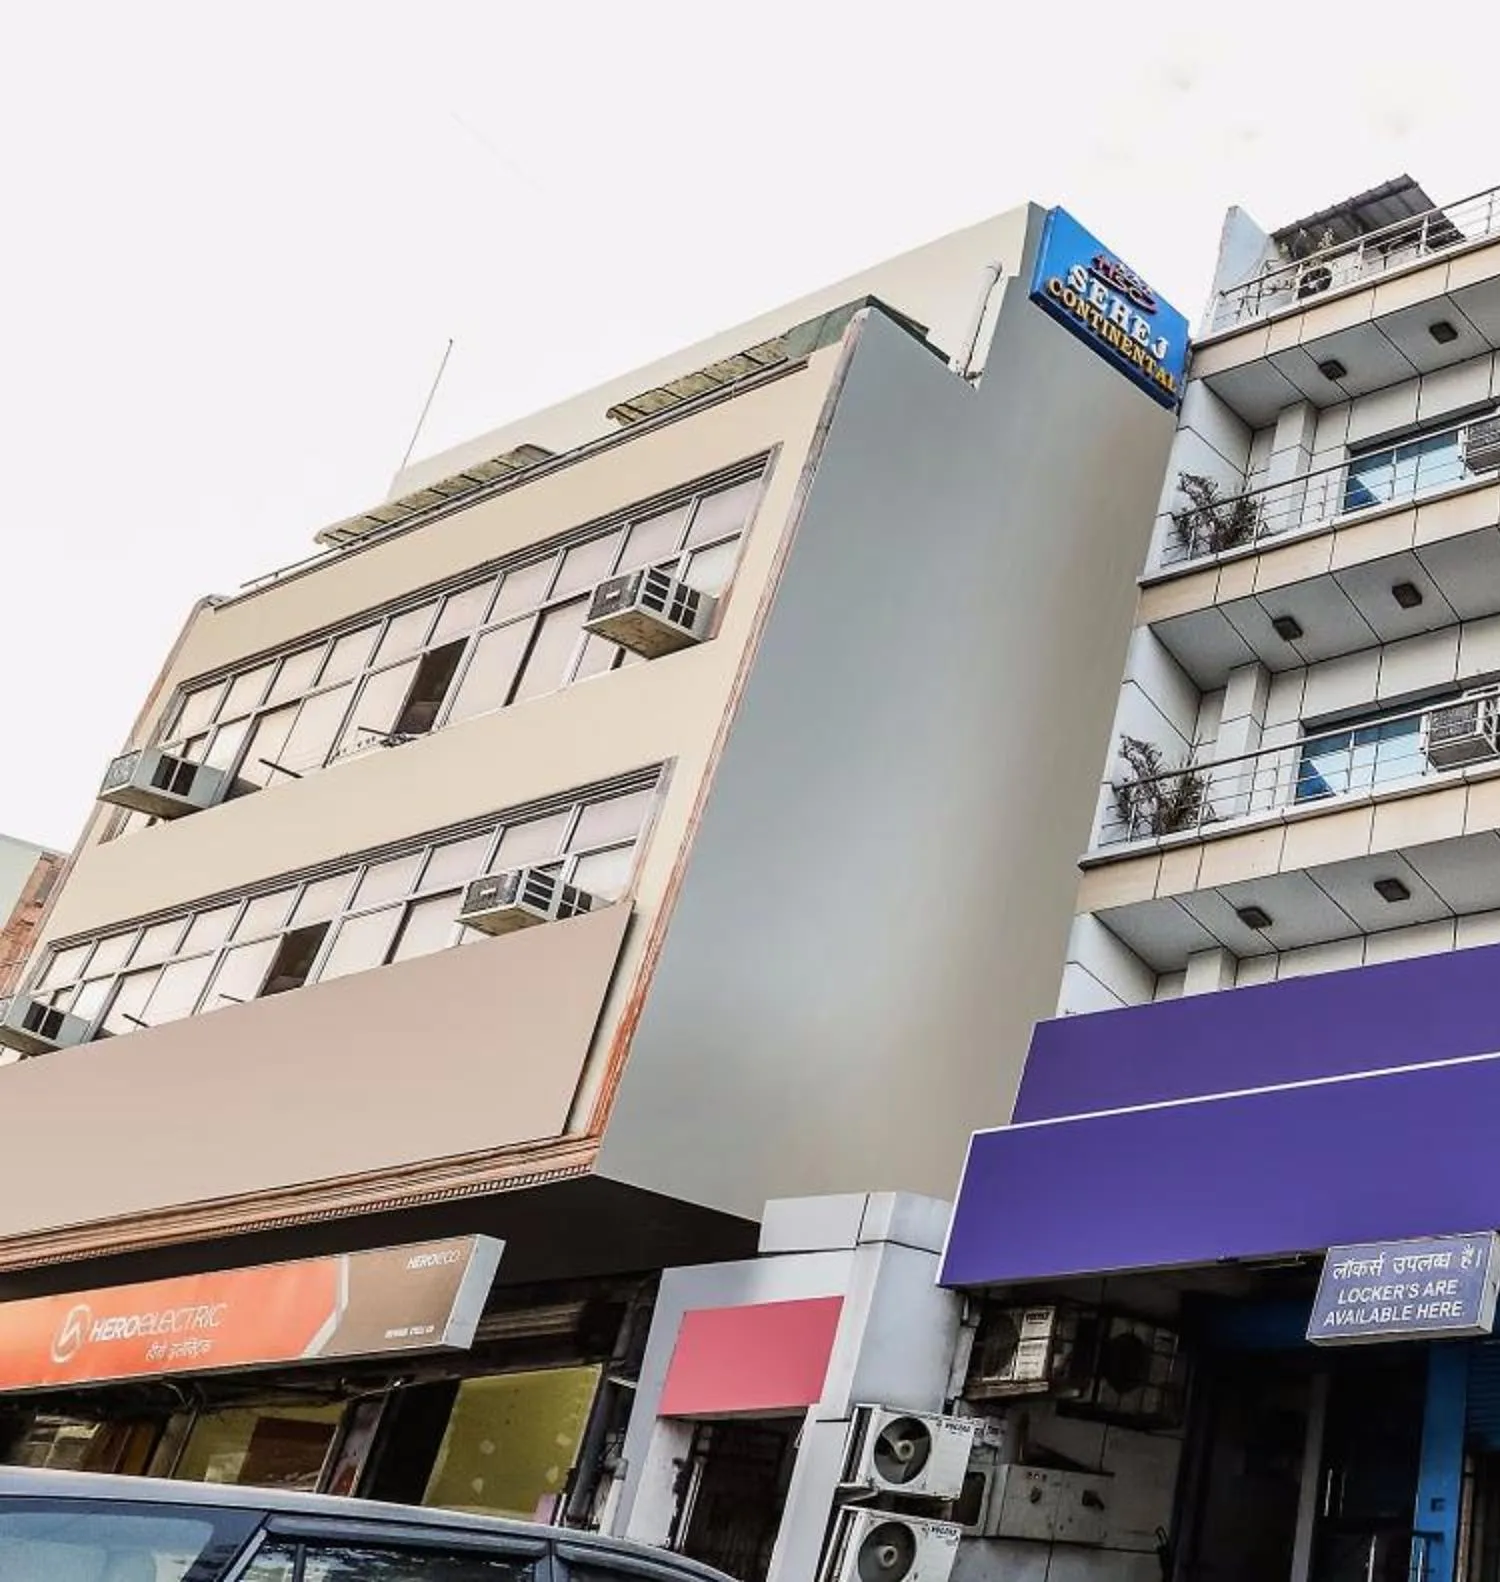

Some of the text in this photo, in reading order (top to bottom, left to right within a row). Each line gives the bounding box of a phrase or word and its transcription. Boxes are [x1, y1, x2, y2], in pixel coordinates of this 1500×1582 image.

[1048, 276, 1177, 391] CONTINENTAL
[1067, 263, 1169, 359] SEHEJ
[1324, 1304, 1413, 1327] AVAILABLE
[1338, 1280, 1459, 1305] LOCKER'S ARE
